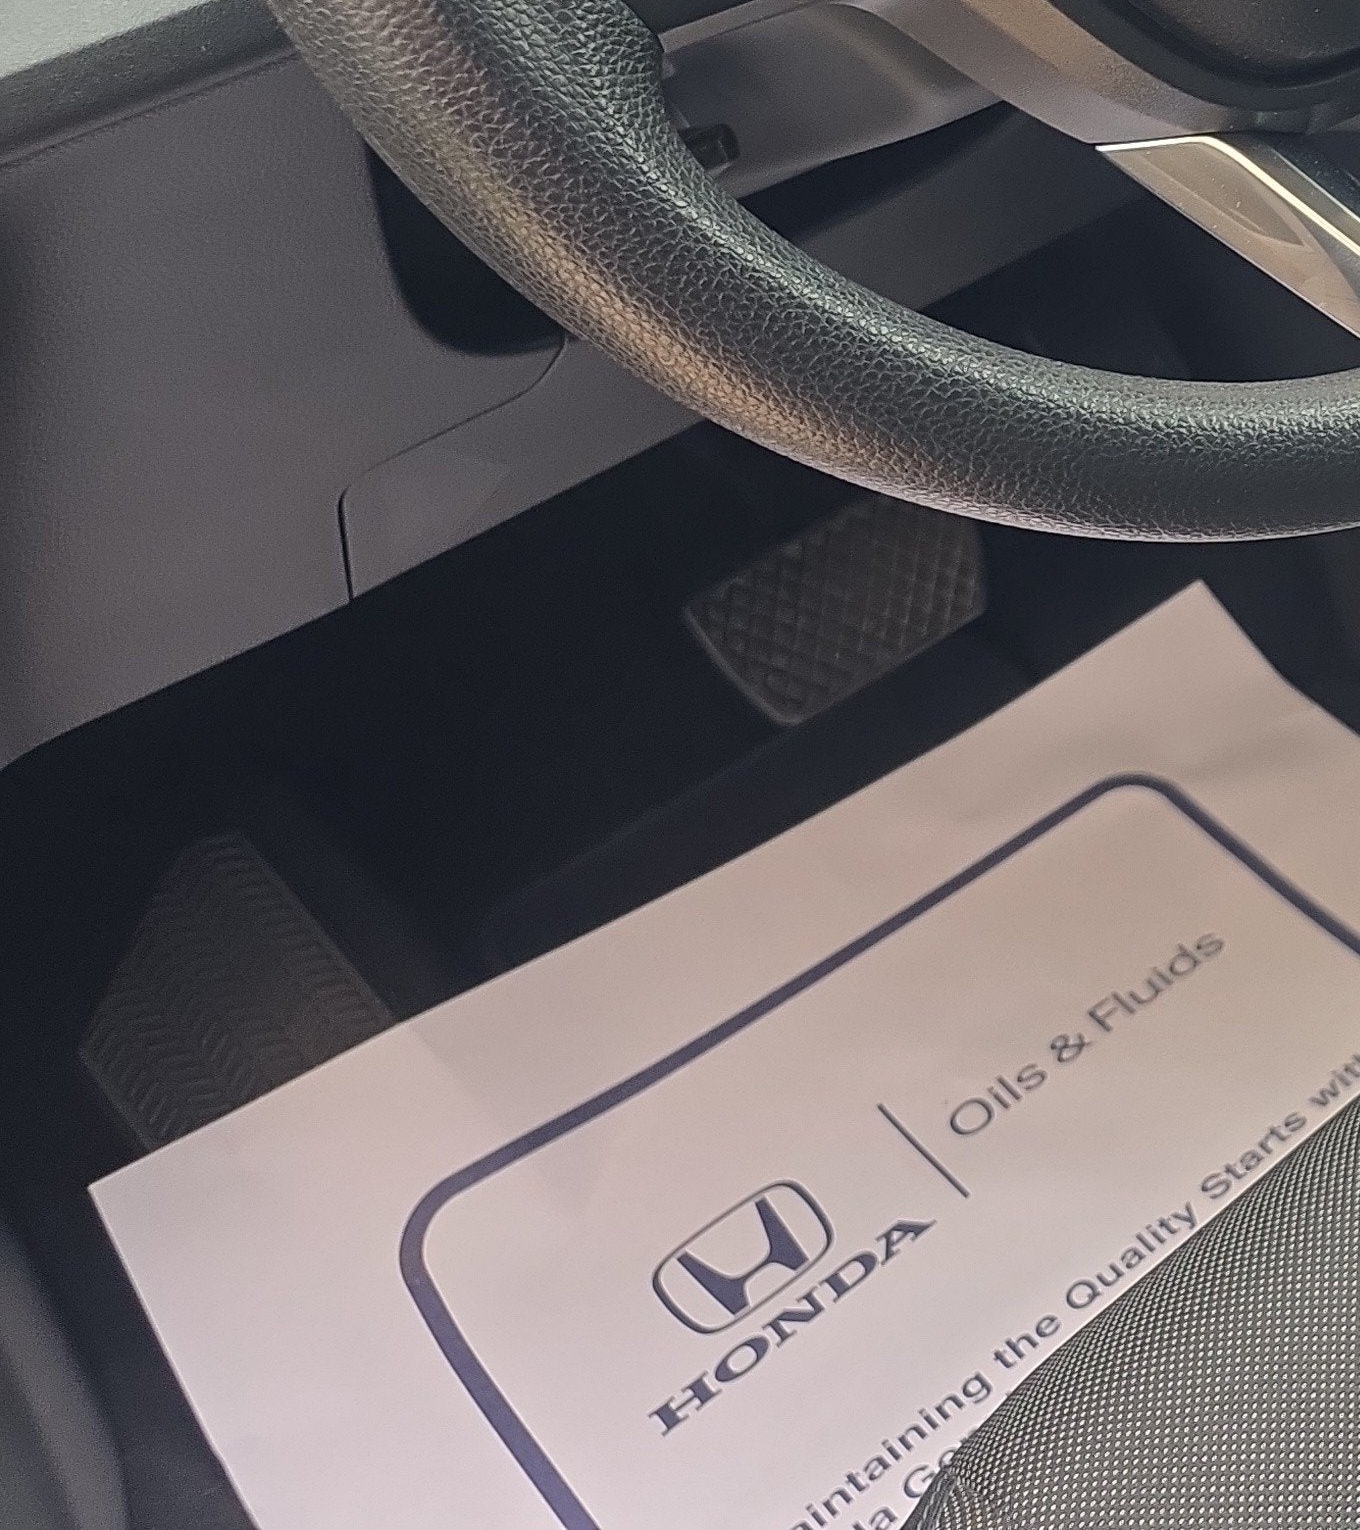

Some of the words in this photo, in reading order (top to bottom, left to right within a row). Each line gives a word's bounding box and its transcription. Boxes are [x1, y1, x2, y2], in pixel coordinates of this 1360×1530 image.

[949, 1062, 1047, 1137] Oils
[1050, 1033, 1091, 1064] &
[1088, 932, 1225, 1034] Fluids
[648, 1220, 937, 1437] HONDA
[993, 1314, 1061, 1370] the
[1065, 1201, 1199, 1311] Quality
[1200, 1110, 1307, 1201] Starts
